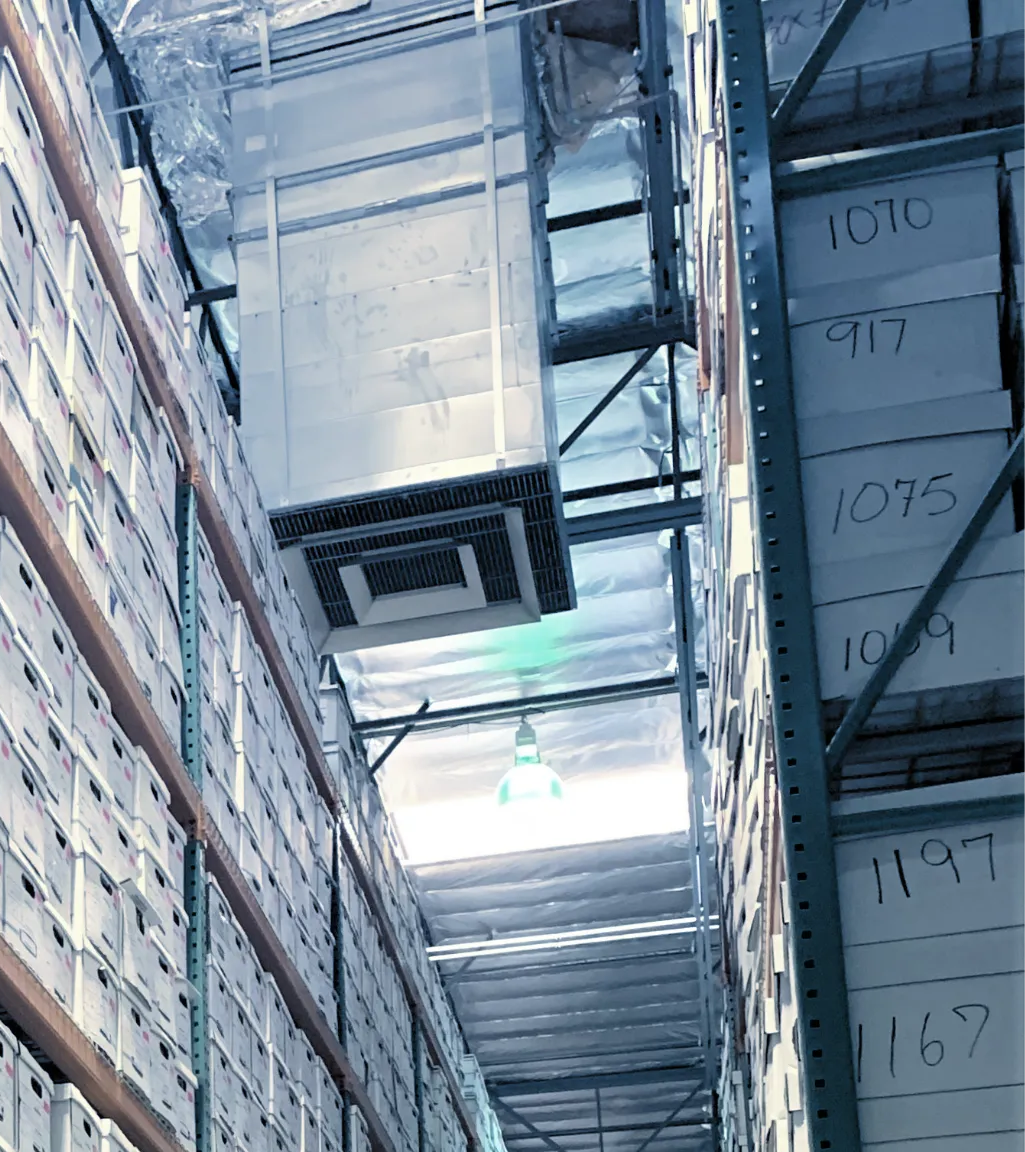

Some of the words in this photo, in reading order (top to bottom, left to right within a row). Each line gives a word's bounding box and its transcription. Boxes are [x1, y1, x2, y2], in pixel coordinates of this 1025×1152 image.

[829, 197, 933, 250] 1070
[825, 318, 908, 359] 917
[832, 472, 958, 535] 1075
[872, 832, 995, 905] 1197
[856, 1004, 990, 1084] 1167
